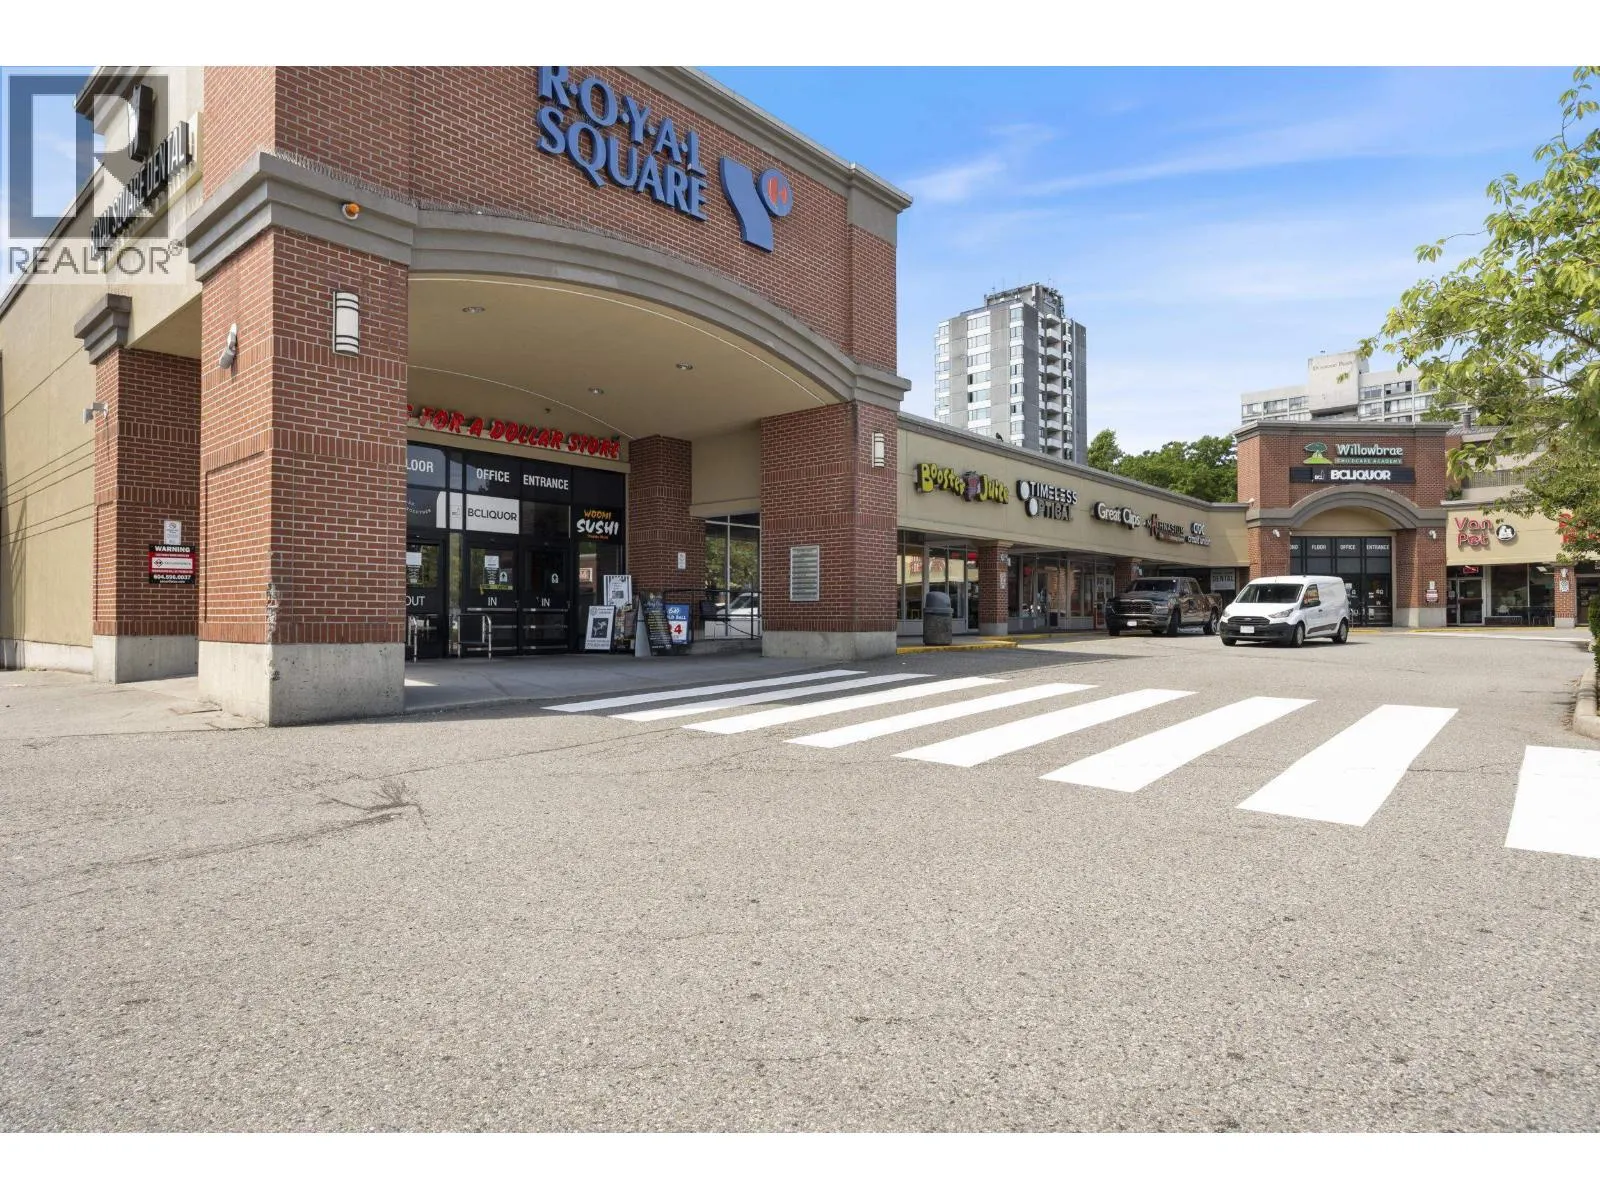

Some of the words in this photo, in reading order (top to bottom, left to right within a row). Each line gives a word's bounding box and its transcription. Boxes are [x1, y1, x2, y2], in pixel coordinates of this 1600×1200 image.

[146, 121, 187, 200] DENTAL
[537, 105, 708, 222] SQUARE
[419, 406, 465, 433] FOR
[469, 417, 484, 437] A
[489, 420, 564, 449] DOLLAR
[568, 433, 621, 459] STORE
[1335, 443, 1404, 456] Willowbrae
[406, 459, 434, 473] LOOR
[476, 468, 510, 483] OFFICE
[523, 474, 569, 490] ENTRANCE
[1330, 470, 1391, 480] BCLIQUOR
[917, 463, 966, 496] Booster
[979, 474, 1009, 504] Juice
[1029, 481, 1078, 505] TIMELESS
[467, 507, 518, 521] BCLIQUOR
[1097, 502, 1121, 522] Great
[1122, 508, 1141, 528] Clips
[576, 518, 619, 535] SUSHI
[1455, 517, 1493, 530] Van
[1458, 532, 1489, 546] Pet
[1212, 575, 1233, 583] DENTAL
[487, 596, 497, 606] IN
[541, 598, 550, 607] IN
